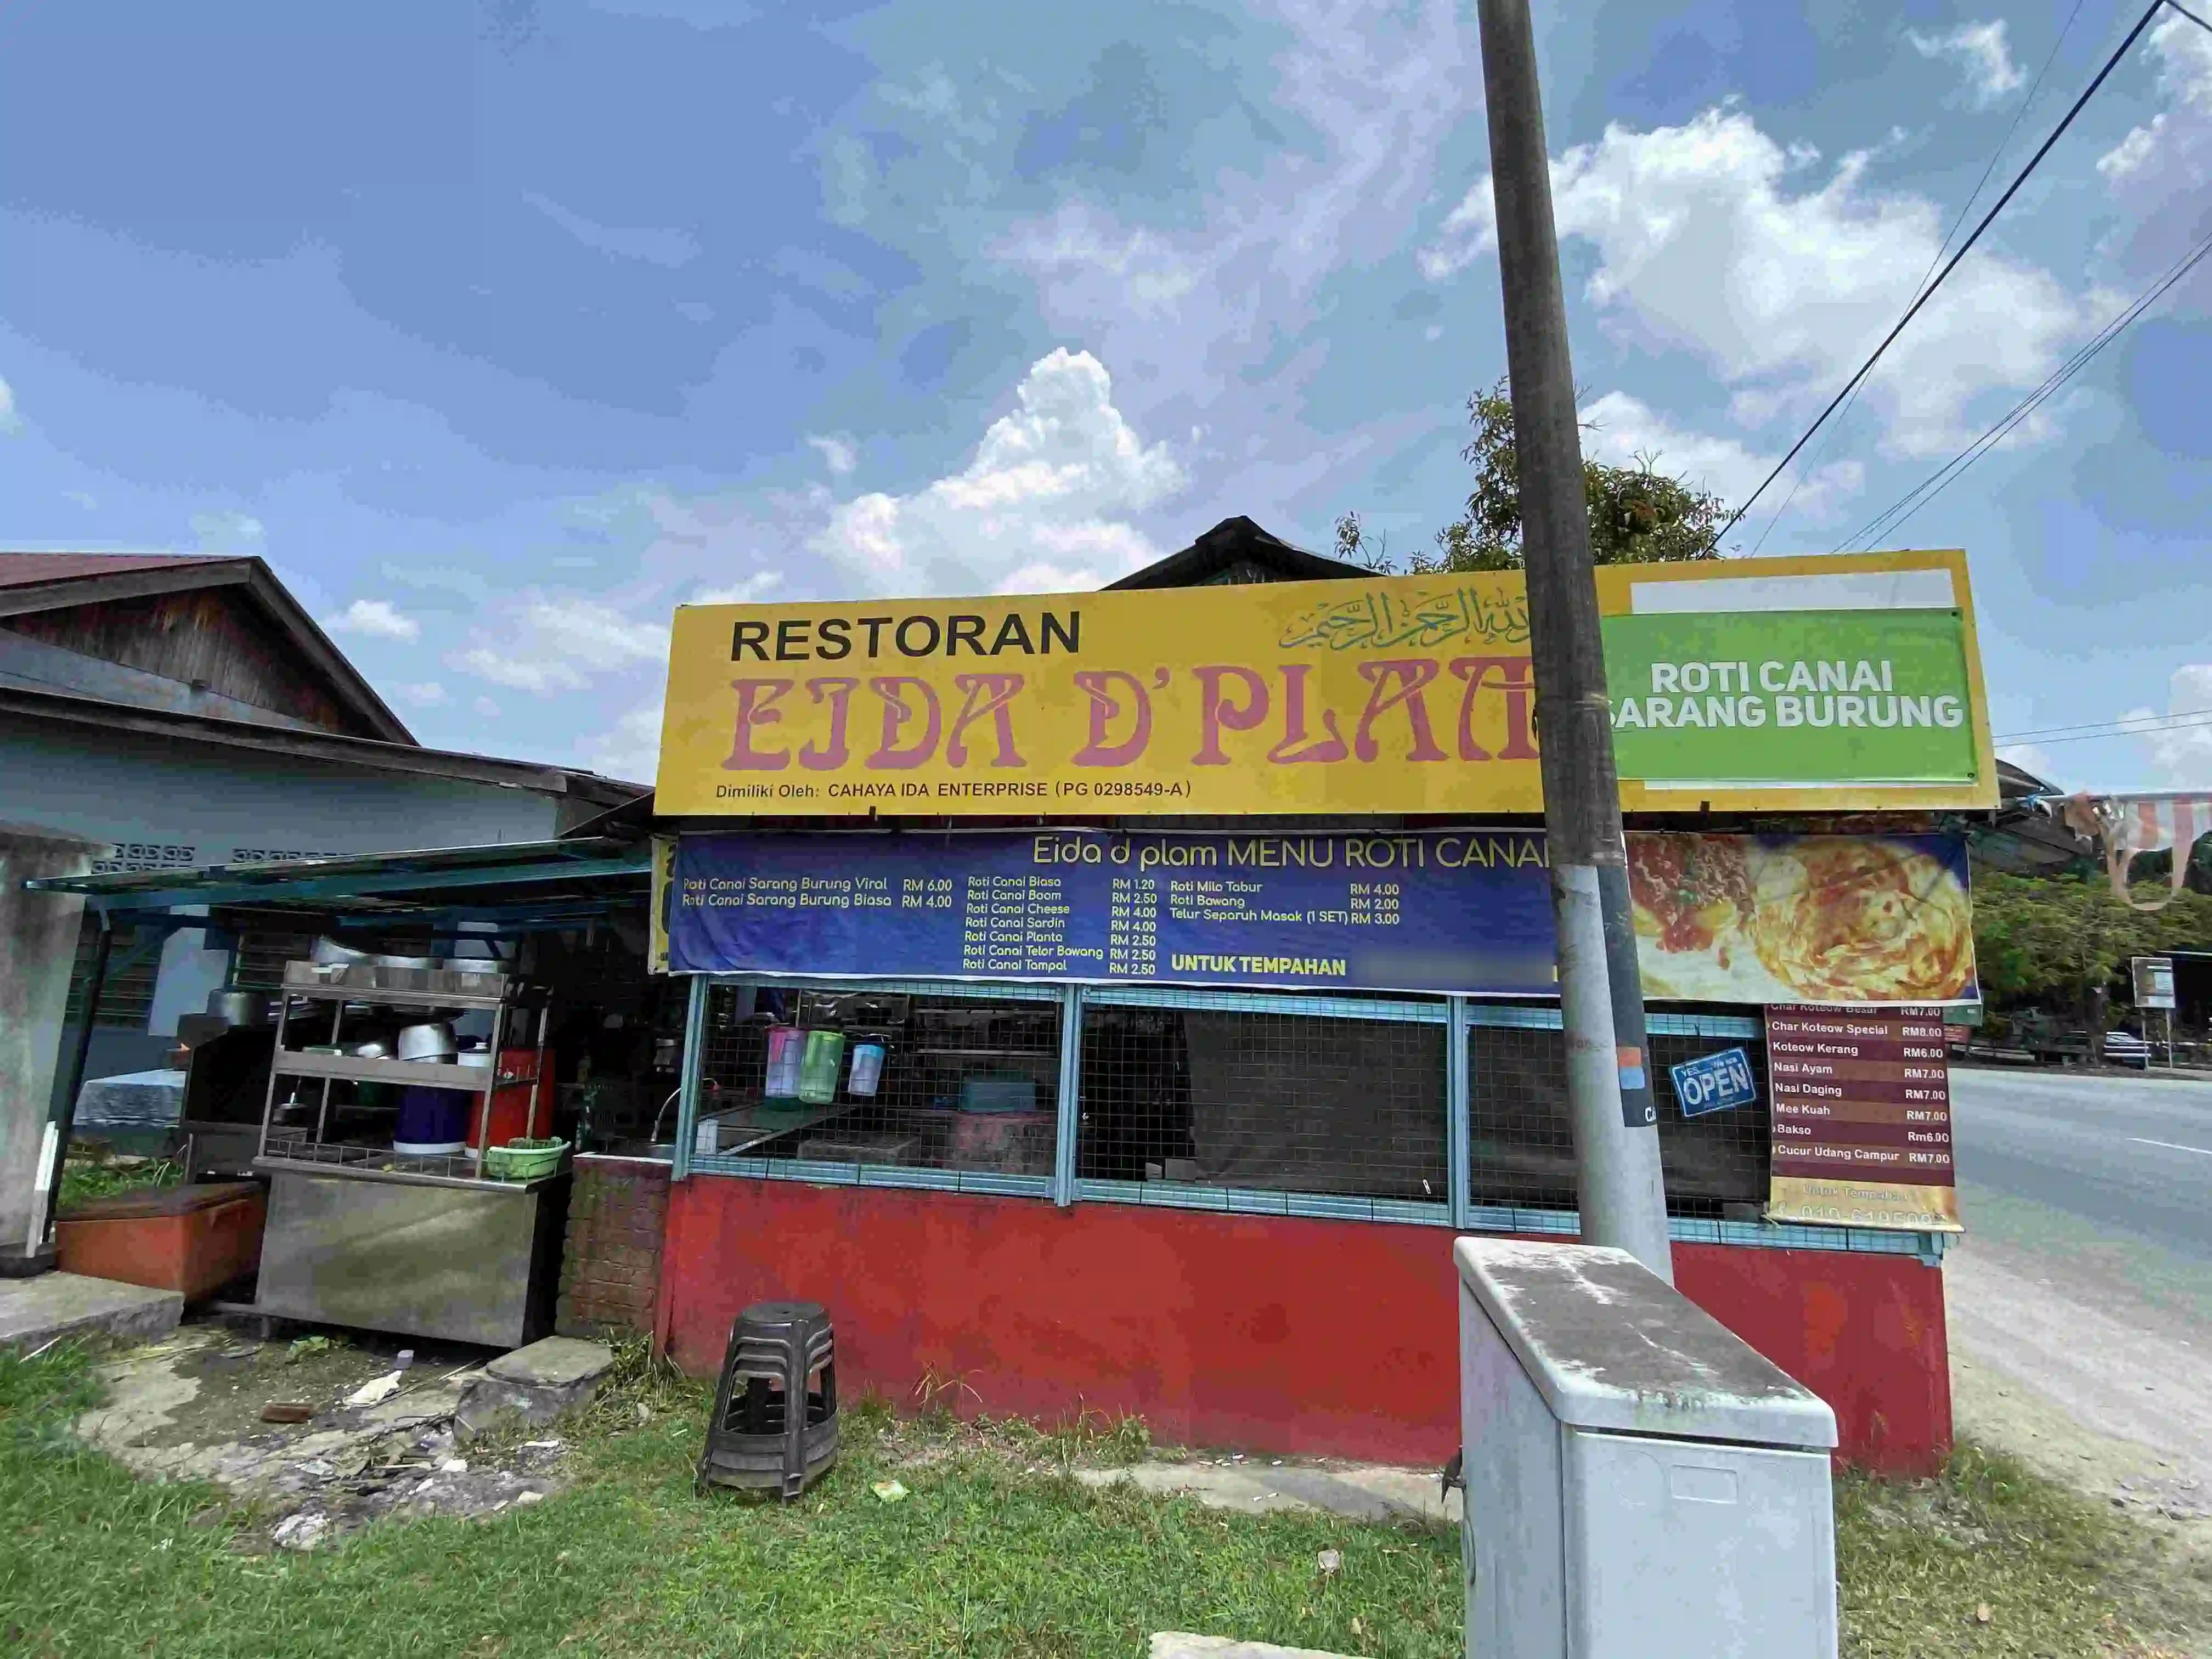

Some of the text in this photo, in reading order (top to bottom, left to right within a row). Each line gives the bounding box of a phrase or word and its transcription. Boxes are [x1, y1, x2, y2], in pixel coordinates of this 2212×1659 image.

[731, 611, 1080, 662] RESTORAN
[1651, 660, 1893, 693] ROTI CANAI
[1776, 695, 1964, 728] BURUNG
[716, 780, 1192, 799] Dimiliki Oleh: CAHAYA IDA ENTERPRISE (PG 0298549-A)
[1034, 836, 1102, 864] Eida
[1141, 839, 1217, 872] plam
[1228, 839, 1334, 868] MENU
[1346, 839, 1424, 868] ROTI
[1436, 838, 1550, 868] CANAI
[684, 877, 888, 893] Roti Canai Sarang Burung Viral
[903, 879, 953, 892] RM 6.00
[968, 877, 1062, 887] Roti Canai Biasa
[1112, 879, 1155, 890] RM 1.20
[1171, 881, 1263, 893] Roti Milo Tabur
[967, 890, 1062, 901] Roti Canai Boom
[1350, 883, 1400, 896] RM 4.00
[682, 894, 892, 909] Roti Canai Sarang Burung Biasa
[902, 895, 952, 909] RM 4.00
[1111, 892, 1157, 904] RM 2.50
[1170, 895, 1245, 909] Roti Bawang
[1350, 898, 1400, 911] RM 2.00
[966, 904, 1070, 915] Roti Canai Cheese
[1111, 906, 1156, 918] RM 4.00
[965, 917, 1065, 928] Roti Canai Sardin
[1169, 909, 1200, 920] Telur
[1203, 909, 1257, 924] Separuh
[1261, 910, 1302, 923] Masak
[1319, 911, 1348, 926] SET)
[1350, 913, 1400, 926] RM 3.00
[1110, 920, 1156, 932] RM 4.00
[964, 931, 1063, 943] Roti Canai Planta
[1110, 934, 1156, 947] RM 2.50
[964, 945, 985, 957] Roti
[989, 945, 1023, 957] Canai
[1057, 946, 1103, 960] Bawang
[1109, 949, 1156, 961] RM 2.50
[963, 958, 1067, 974] Roti Canai Tampal
[1109, 962, 1156, 975] RM 2.50
[1171, 953, 1235, 973] UNTUK
[1239, 955, 1347, 977] TEMPAHAN
[1771, 1021, 1888, 1036] Char Koteow Special
[1902, 1026, 1942, 1037] RM8.00
[1773, 1041, 1859, 1057] Koteow Kerang
[1903, 1047, 1944, 1058] RM6.00
[1774, 1062, 1833, 1075] Nasi Ayam
[1904, 1068, 1945, 1079] RM7.00
[1683, 1063, 1750, 1105] OPEN
[1775, 1082, 1842, 1097] Nasi Daging
[1905, 1089, 1946, 1100] RM7.00
[1776, 1103, 1831, 1115] Mee Kuah
[1906, 1110, 1948, 1121] RM7.00
[1778, 1124, 1812, 1135] Bakso
[1908, 1131, 1949, 1143] Rm6.00
[1778, 1144, 1900, 1163] Cucur Udang Campur
[1909, 1153, 1950, 1164] RM7.00
